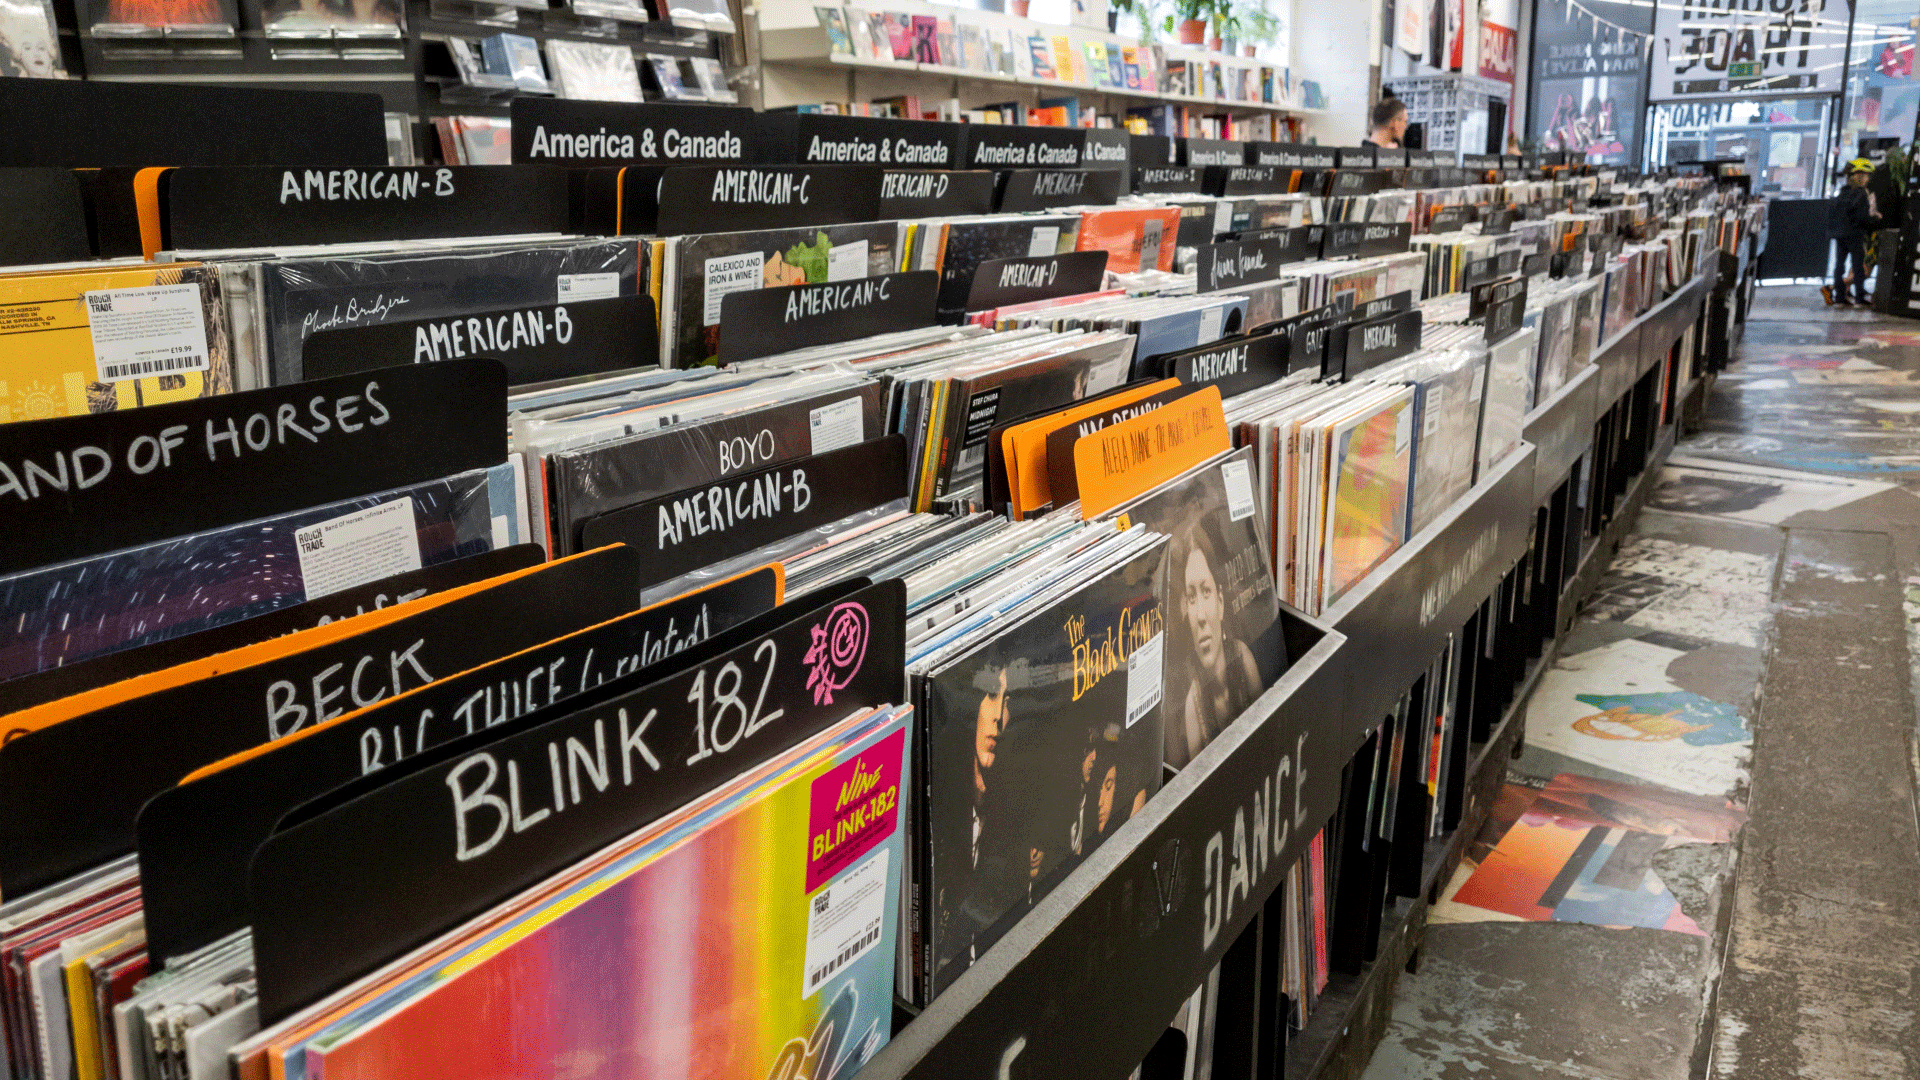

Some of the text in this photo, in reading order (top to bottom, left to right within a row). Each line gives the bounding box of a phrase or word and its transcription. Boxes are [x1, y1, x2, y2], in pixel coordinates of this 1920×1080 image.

[530, 125, 741, 159] America & Canada
[807, 135, 948, 164] America & Canada
[975, 141, 1077, 164] America & Canada
[1086, 141, 1126, 161] & Canada
[280, 169, 455, 204] AMERICAN-B
[712, 169, 811, 204] AMERICAN-C
[880, 173, 949, 199] MERICAN-D
[708, 269, 753, 286] IRON & WINE
[709, 257, 761, 274] CALEXICO AND
[1000, 260, 1058, 289] AMERICAN-D
[91, 303, 114, 313] TRADE
[785, 277, 890, 323] AMERICAN-C
[171, 345, 192, 354] £19.99
[414, 306, 573, 364] AMERICAN-B
[969, 405, 997, 422] MIDNIGHT
[0, 381, 391, 502] AND OF HORSES
[719, 428, 775, 475] BOYO
[658, 469, 812, 550] AMERICAN-B
[298, 527, 323, 545] ROUGH
[300, 538, 326, 554] TRADE
[1063, 614, 1086, 649] The
[1071, 625, 1119, 702] Black
[1118, 602, 1164, 663] Crowes
[267, 638, 434, 742] BECK
[447, 704, 660, 863] BLINK
[686, 638, 785, 768] 182
[812, 784, 897, 862] BLINK-182
[1203, 730, 1309, 952] DANCE
